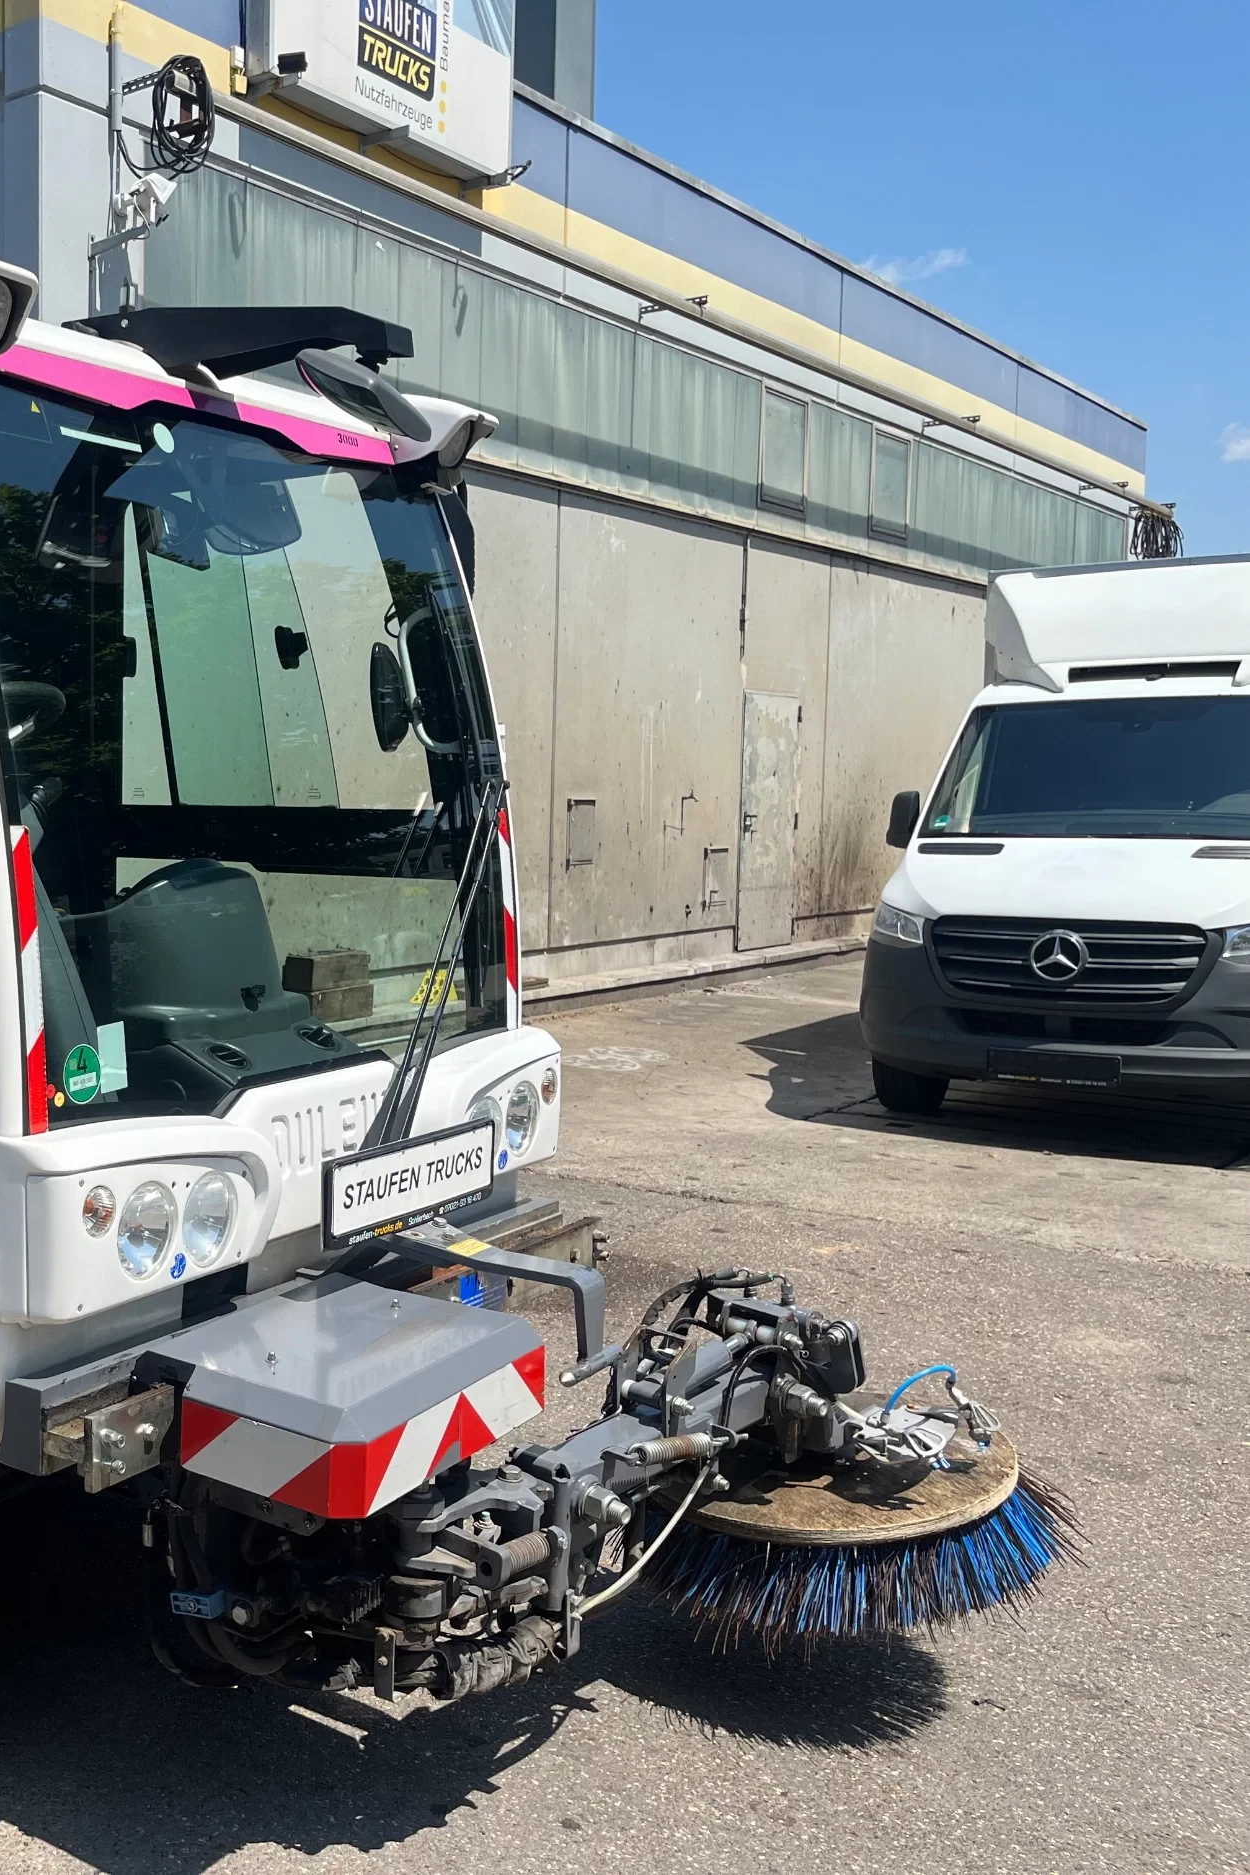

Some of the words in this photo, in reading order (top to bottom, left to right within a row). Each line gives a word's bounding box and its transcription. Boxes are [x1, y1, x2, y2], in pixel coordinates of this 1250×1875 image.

[363, 33, 431, 92] TRUCKS
[354, 75, 433, 130] Nutzfahrzeuge
[337, 432, 359, 448] 3000
[77, 1048, 87, 1073] 4
[343, 1165, 421, 1209] STAUFEN
[426, 1146, 483, 1184] TRUCKS
[348, 1221, 403, 1245] staufen-trucks.de
